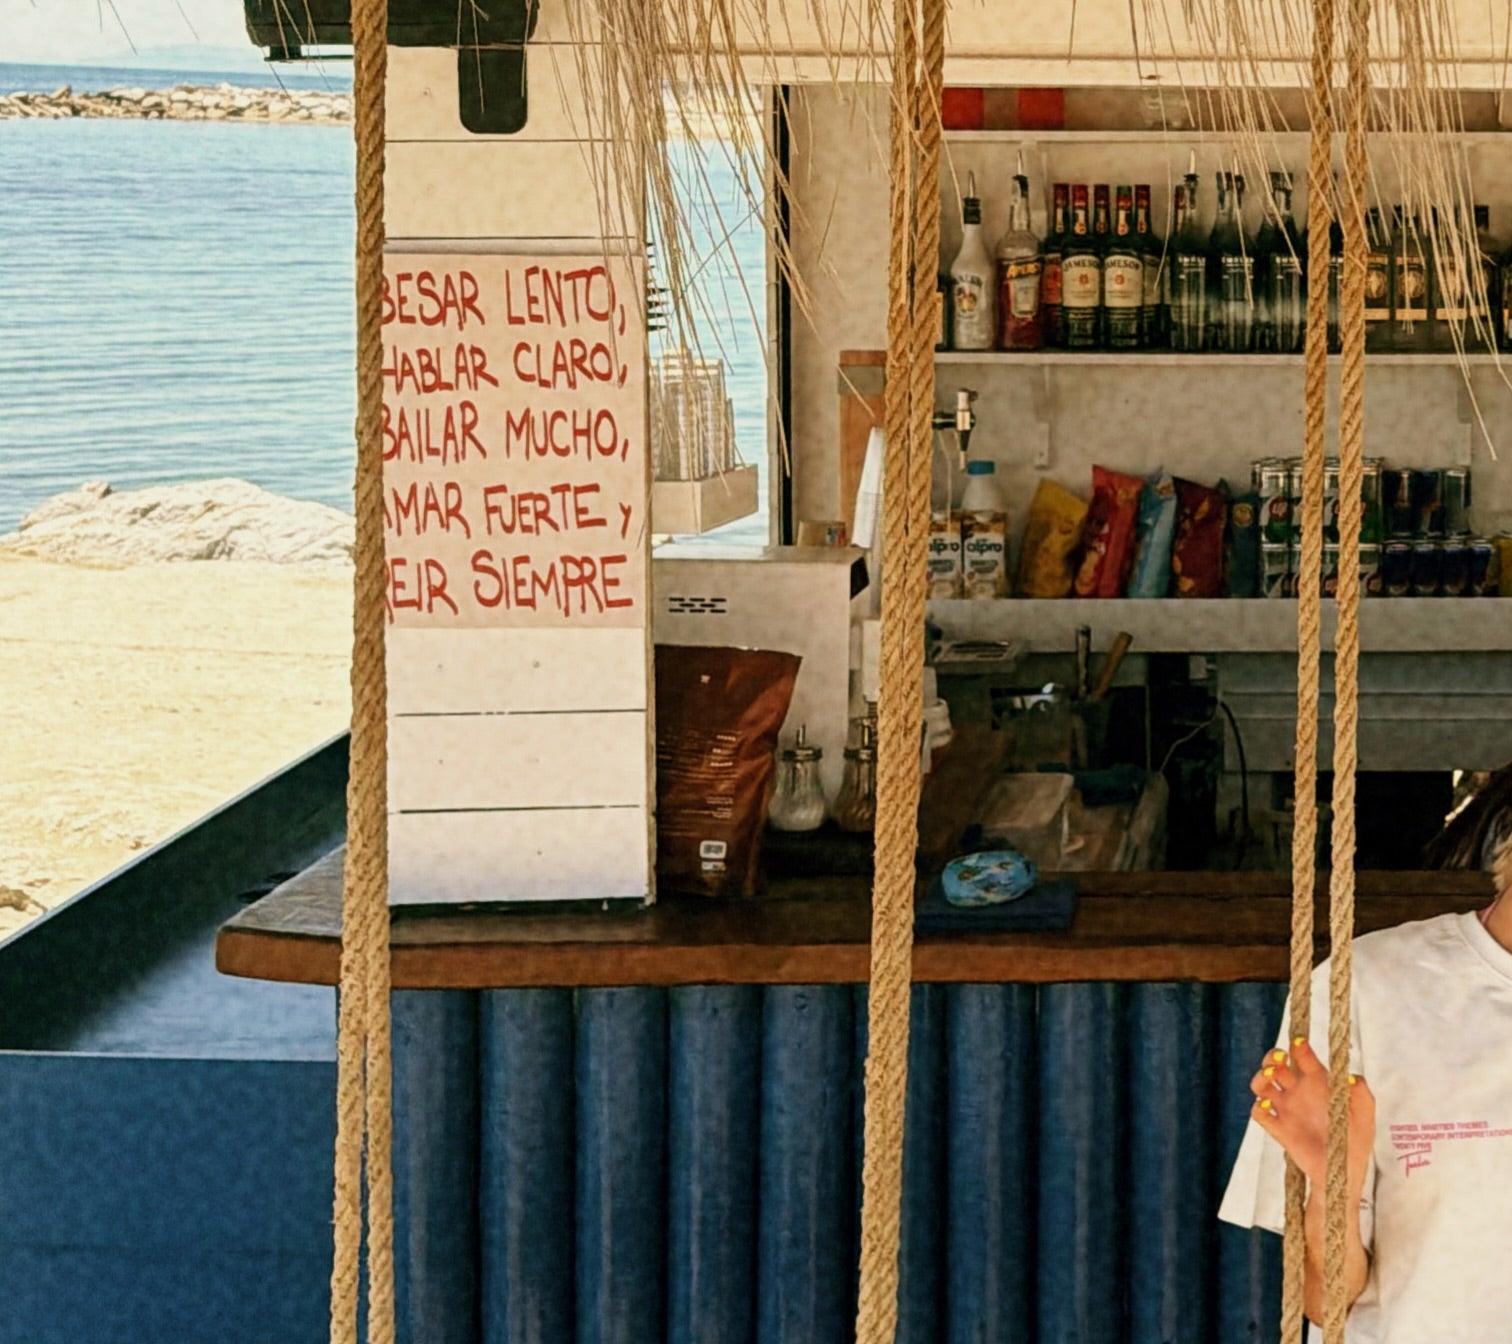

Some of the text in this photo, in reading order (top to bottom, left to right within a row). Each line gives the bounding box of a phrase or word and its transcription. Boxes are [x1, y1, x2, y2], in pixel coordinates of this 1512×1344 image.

[1105, 258, 1140, 271] AMESON
[505, 266, 626, 335] LENTO,
[512, 338, 628, 389] CLARO,
[505, 407, 629, 462] MUCHO,
[483, 482, 607, 536] FUERTE
[471, 548, 634, 617] SIEMPRE
